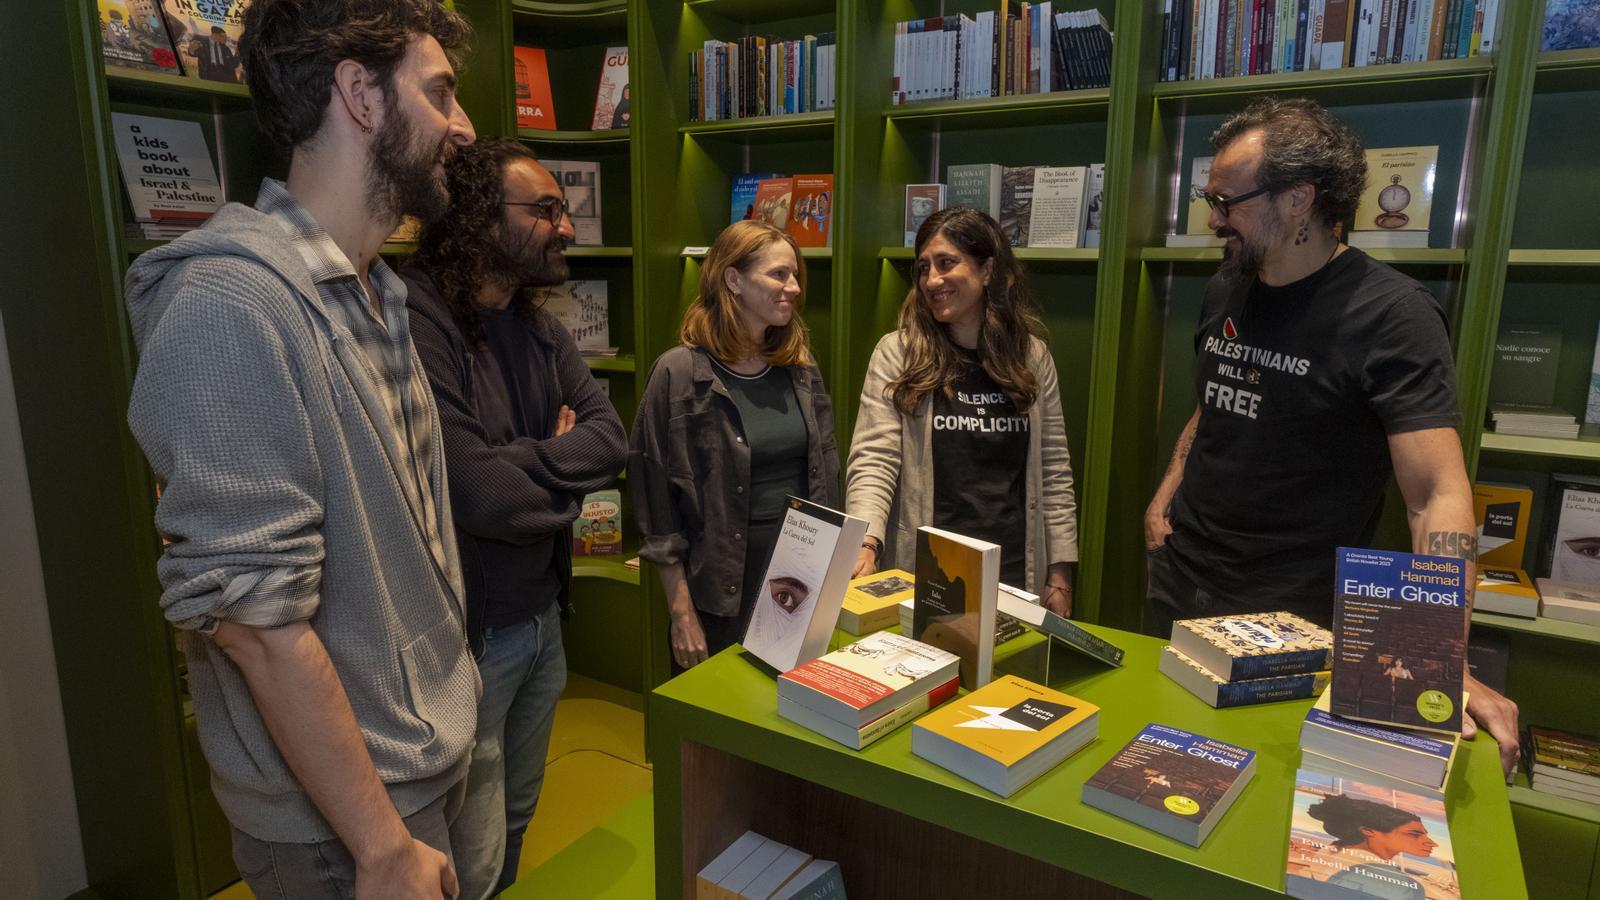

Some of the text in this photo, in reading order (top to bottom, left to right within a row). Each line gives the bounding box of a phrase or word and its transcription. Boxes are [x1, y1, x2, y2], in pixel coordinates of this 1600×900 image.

[175, 0, 243, 18] IN GAZA
[187, 11, 227, 23] COLORING
[130, 125, 141, 133] a
[133, 135, 169, 149] kids
[137, 149, 180, 163] book
[142, 163, 191, 177] about
[953, 170, 984, 178] HANNAH
[140, 178, 192, 191] Israel &
[1039, 177, 1079, 185] Disappearance
[156, 190, 216, 203] Palestine
[1496, 344, 1520, 352] Nadie
[1204, 336, 1311, 376] PALESTINIANS
[1513, 355, 1542, 363] sangre
[1217, 362, 1244, 380] WILL
[957, 391, 1006, 405] SILENCE
[1204, 380, 1262, 419] FREE
[976, 407, 986, 415] IS
[933, 415, 1029, 432] COMPLICITY
[1567, 495, 1585, 503] Elias
[786, 515, 818, 536] Elias Khoury
[783, 527, 788, 535] La
[788, 529, 800, 541] Cueva
[807, 537, 816, 546] Sol
[1411, 559, 1460, 574] Isabella
[1400, 570, 1460, 587] Hammad
[1344, 579, 1459, 607] Enter Ghost
[1280, 663, 1305, 671] PARISIAN
[1267, 689, 1293, 697] PARISIAN
[1031, 707, 1054, 718] porta
[1138, 734, 1184, 750] Enter
[1187, 747, 1240, 769] Ghost
[1192, 741, 1246, 761] Hammad
[1206, 739, 1249, 756] Isabella
[1302, 838, 1338, 853] Entra
[1301, 854, 1419, 890] Isabella Hammad
